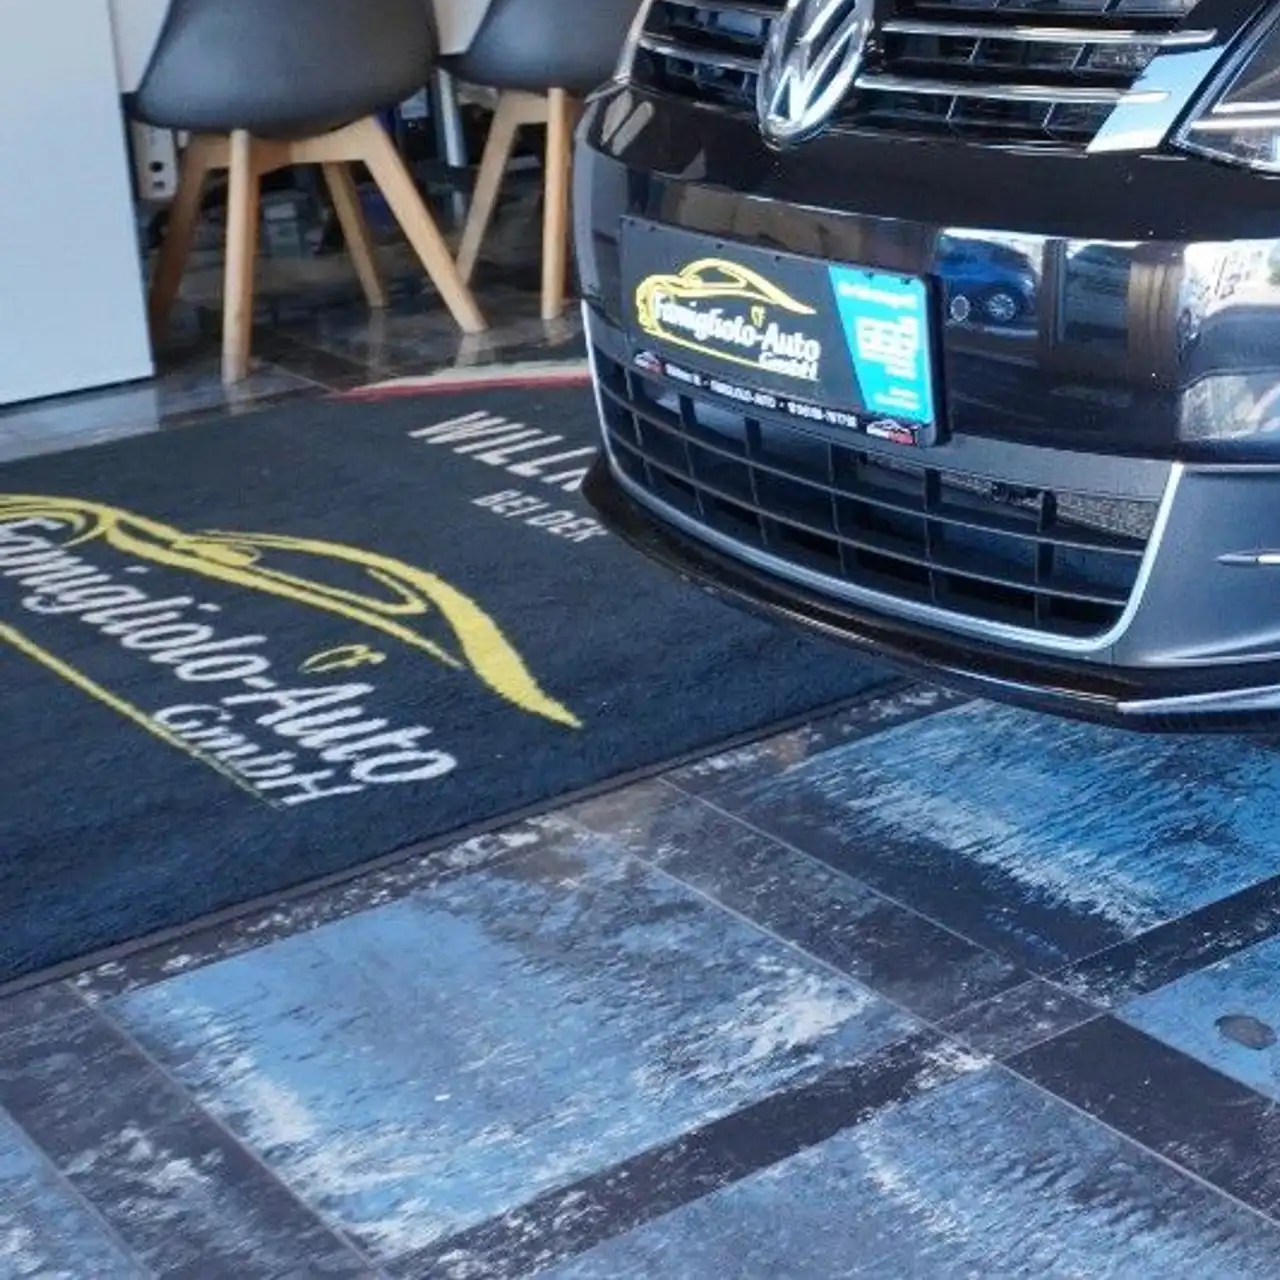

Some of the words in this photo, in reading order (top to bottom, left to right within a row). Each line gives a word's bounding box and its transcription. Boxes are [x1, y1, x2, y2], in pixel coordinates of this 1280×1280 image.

[471, 488, 552, 519] BEI
[524, 509, 609, 543] DER
[151, 703, 363, 807] GmbH
